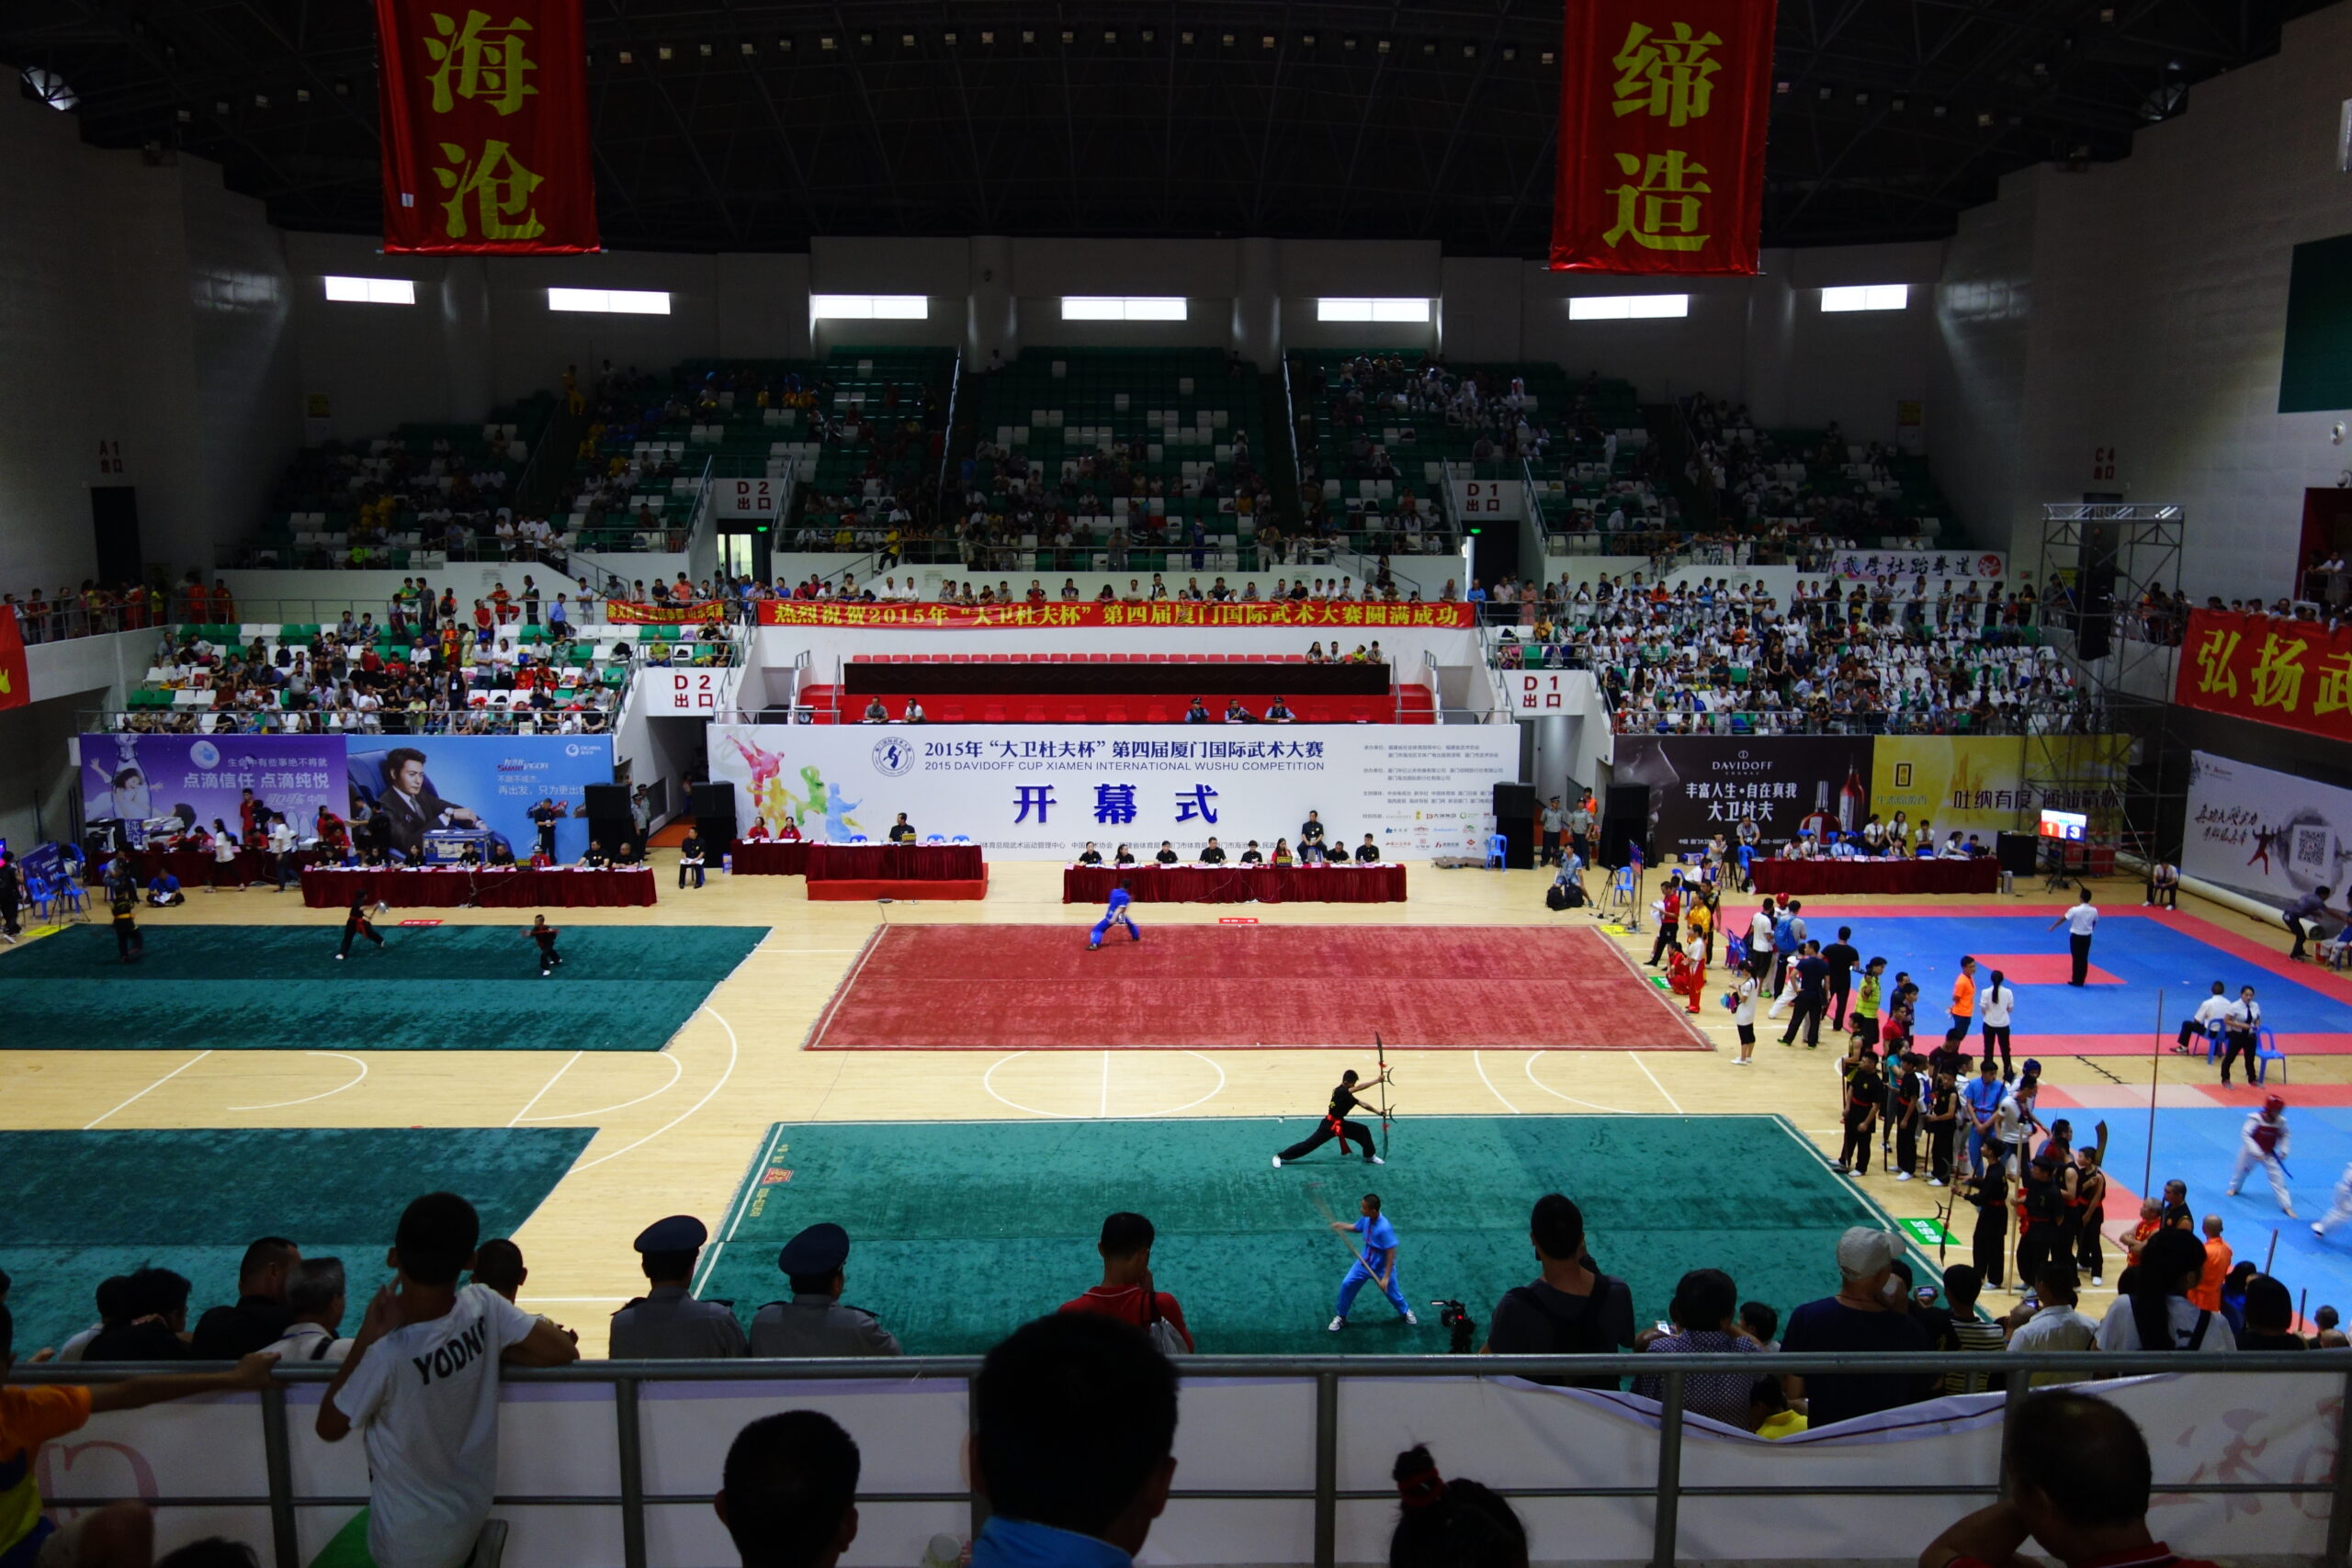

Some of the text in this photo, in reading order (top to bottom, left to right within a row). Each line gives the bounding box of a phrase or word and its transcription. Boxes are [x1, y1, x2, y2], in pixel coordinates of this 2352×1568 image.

[423, 9, 546, 240] 海沧
[1602, 21, 1724, 252] 缔造
[737, 497, 771, 511] 出口
[1466, 499, 1500, 512] 出口
[674, 694, 713, 707] 出口
[1522, 694, 1561, 708] 出口
[924, 761, 1324, 771] 2015 DAVIDOFF CUP XIAMEN INTERNATIONAL WUSHU COMPETITION
[1712, 761, 1773, 770] DAVIDOFF
[184, 773, 330, 789] 点滴信任 点滴纯悦
[1953, 790, 2032, 809] 吐纳有度
[1707, 801, 1774, 822] 大卫杜夫
[2069, 826, 2081, 839] 3
